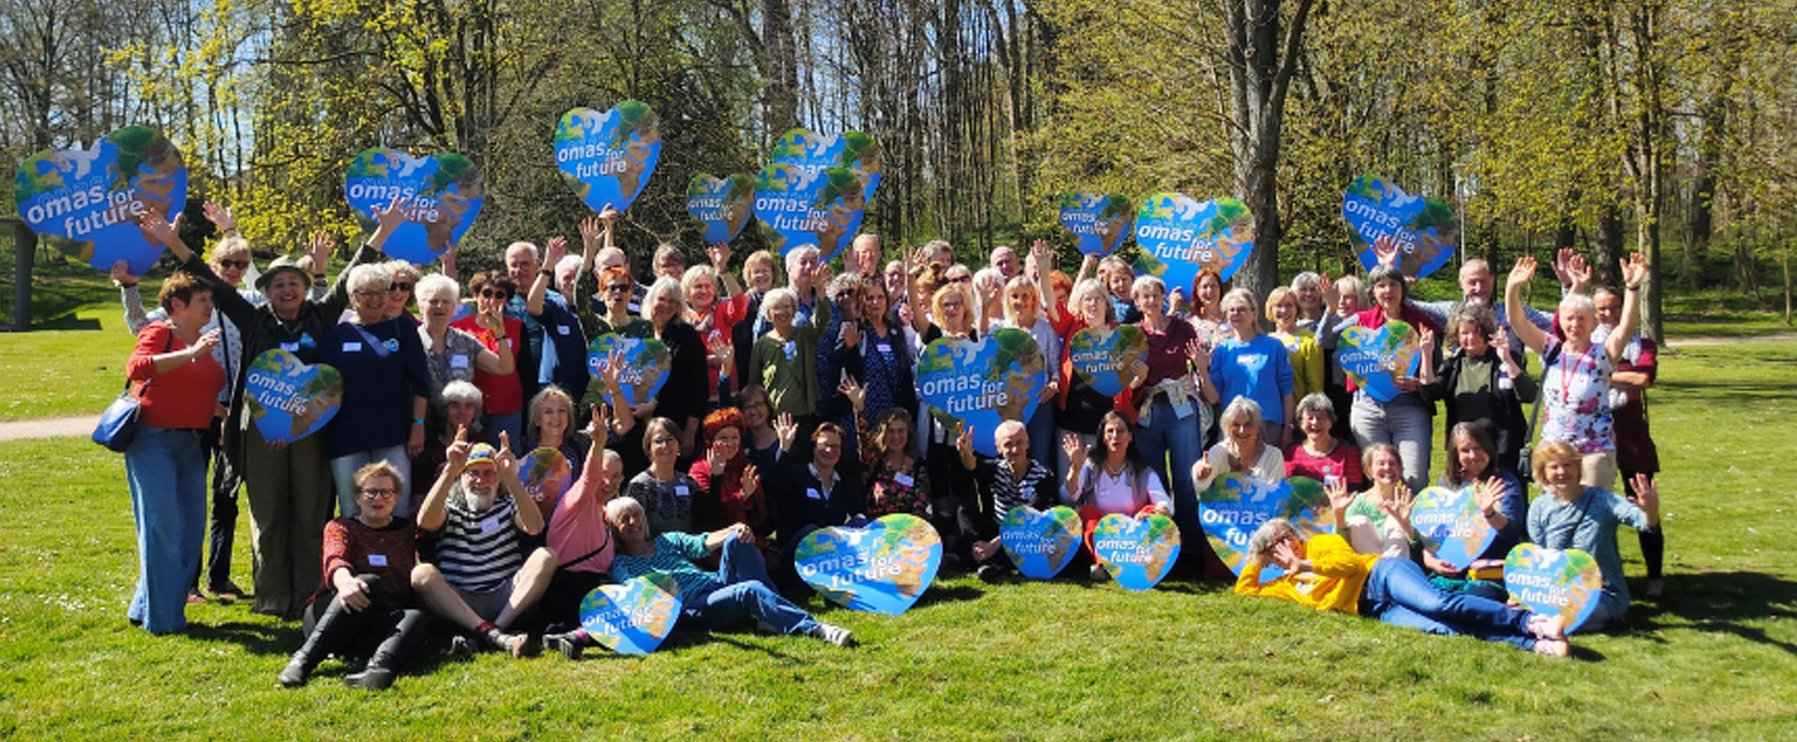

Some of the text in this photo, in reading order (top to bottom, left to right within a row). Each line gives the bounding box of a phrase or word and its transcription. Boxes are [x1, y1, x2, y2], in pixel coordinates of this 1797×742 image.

[558, 142, 624, 162] omas for
[576, 158, 626, 178] future
[27, 186, 135, 224] omas for
[350, 184, 437, 210] omas for
[686, 198, 721, 209] omas
[699, 208, 734, 221] future
[756, 198, 827, 219] omas for
[1062, 211, 1096, 224] omas
[65, 201, 145, 239] future
[774, 213, 828, 232] future
[1073, 223, 1109, 235] future
[1346, 200, 1416, 243] omas for
[1138, 224, 1212, 252] omas for
[1154, 242, 1212, 263] future
[1072, 351, 1108, 362] omas
[1341, 350, 1378, 363] omas
[1086, 362, 1124, 374] future
[1356, 361, 1396, 376] future
[248, 373, 309, 406] omas for
[923, 374, 1004, 396] omas for
[258, 390, 306, 416] future
[947, 392, 1008, 414] future
[1203, 509, 1269, 526] omas
[1415, 513, 1457, 526] omas
[1001, 529, 1040, 542] omas
[1430, 526, 1473, 538] future
[1015, 541, 1056, 554] future
[1096, 540, 1151, 555] omas for
[1111, 551, 1153, 564] future
[803, 552, 894, 577] omas for
[832, 563, 902, 588] future
[1506, 571, 1567, 594] omas for
[1521, 587, 1568, 606] future
[583, 605, 634, 628] omas
[603, 612, 656, 635] future
